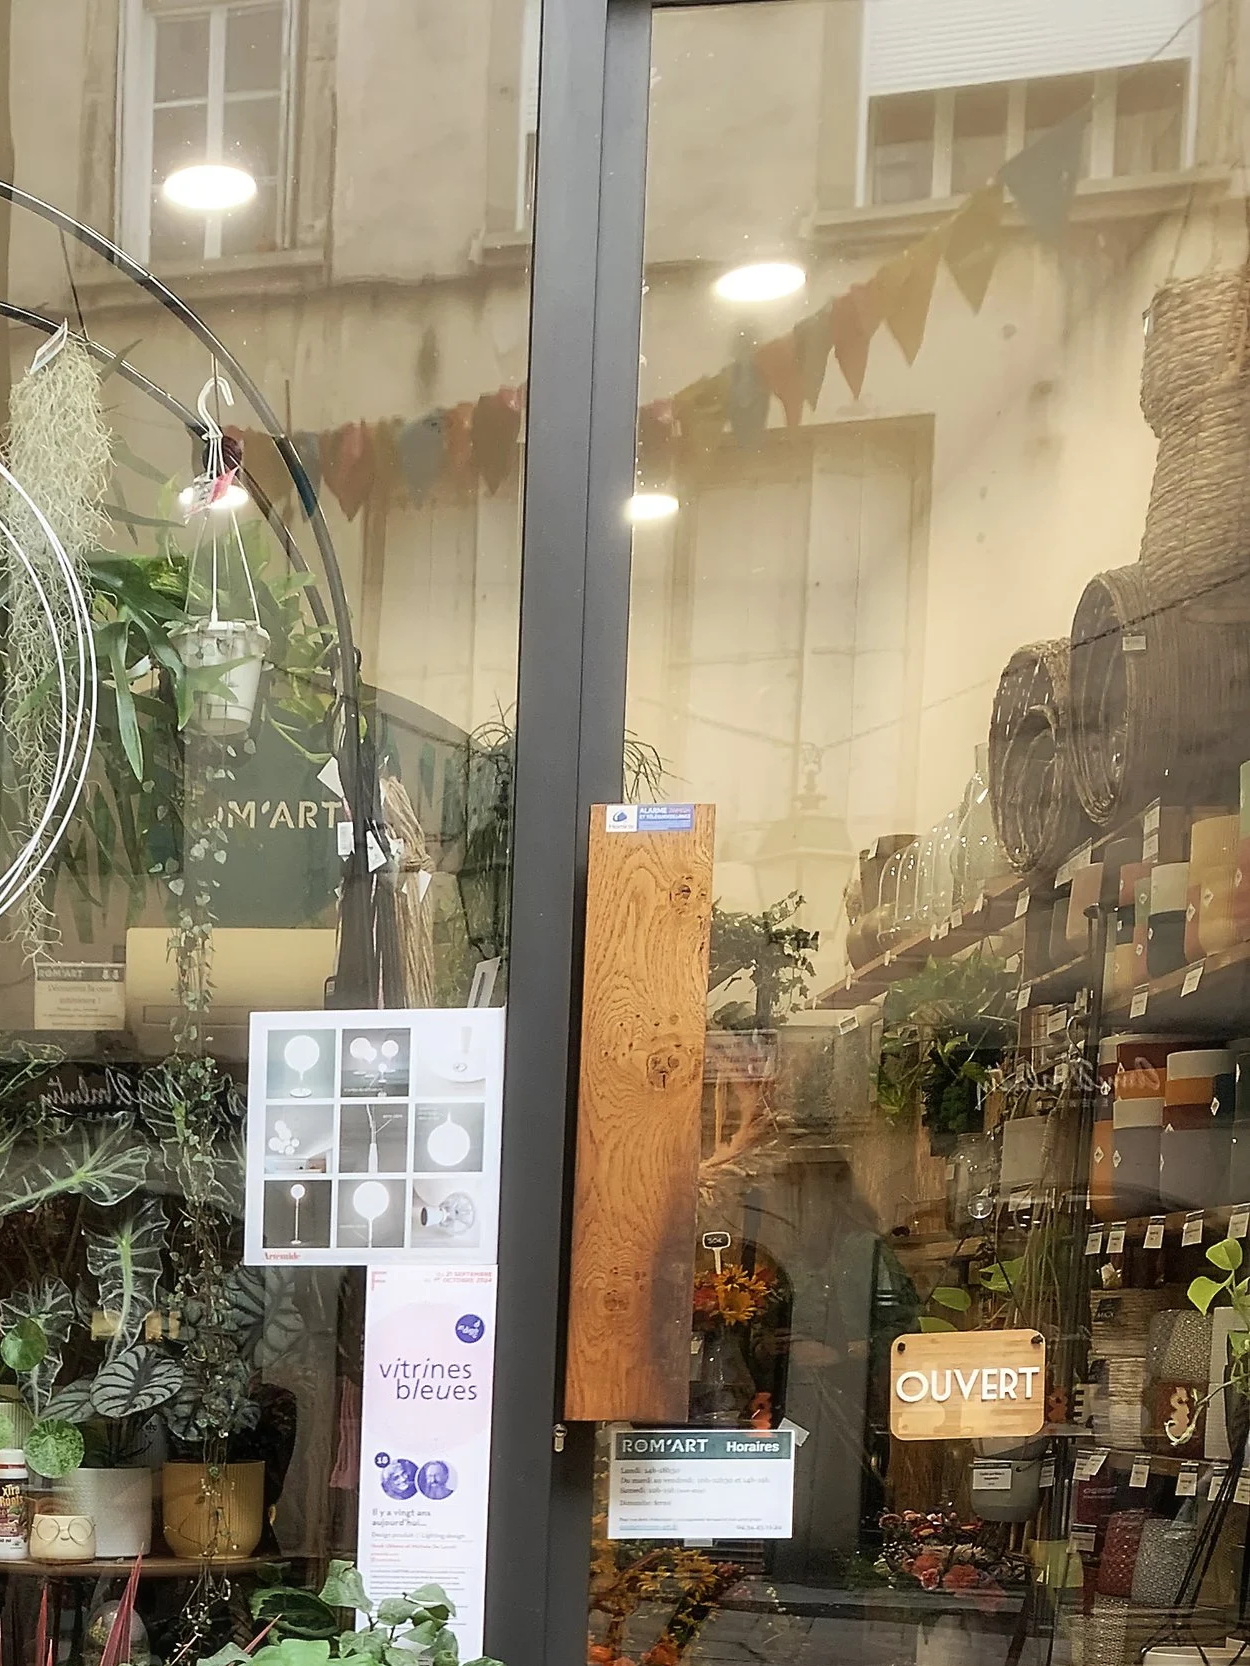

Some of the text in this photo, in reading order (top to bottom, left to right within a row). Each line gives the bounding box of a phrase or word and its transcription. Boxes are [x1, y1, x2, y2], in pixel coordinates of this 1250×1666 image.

[379, 1357, 473, 1379] vitrines
[396, 1378, 478, 1401] bleues
[896, 1367, 1040, 1403] OUVERT
[622, 1437, 780, 1453] ROM'ART Horaires
